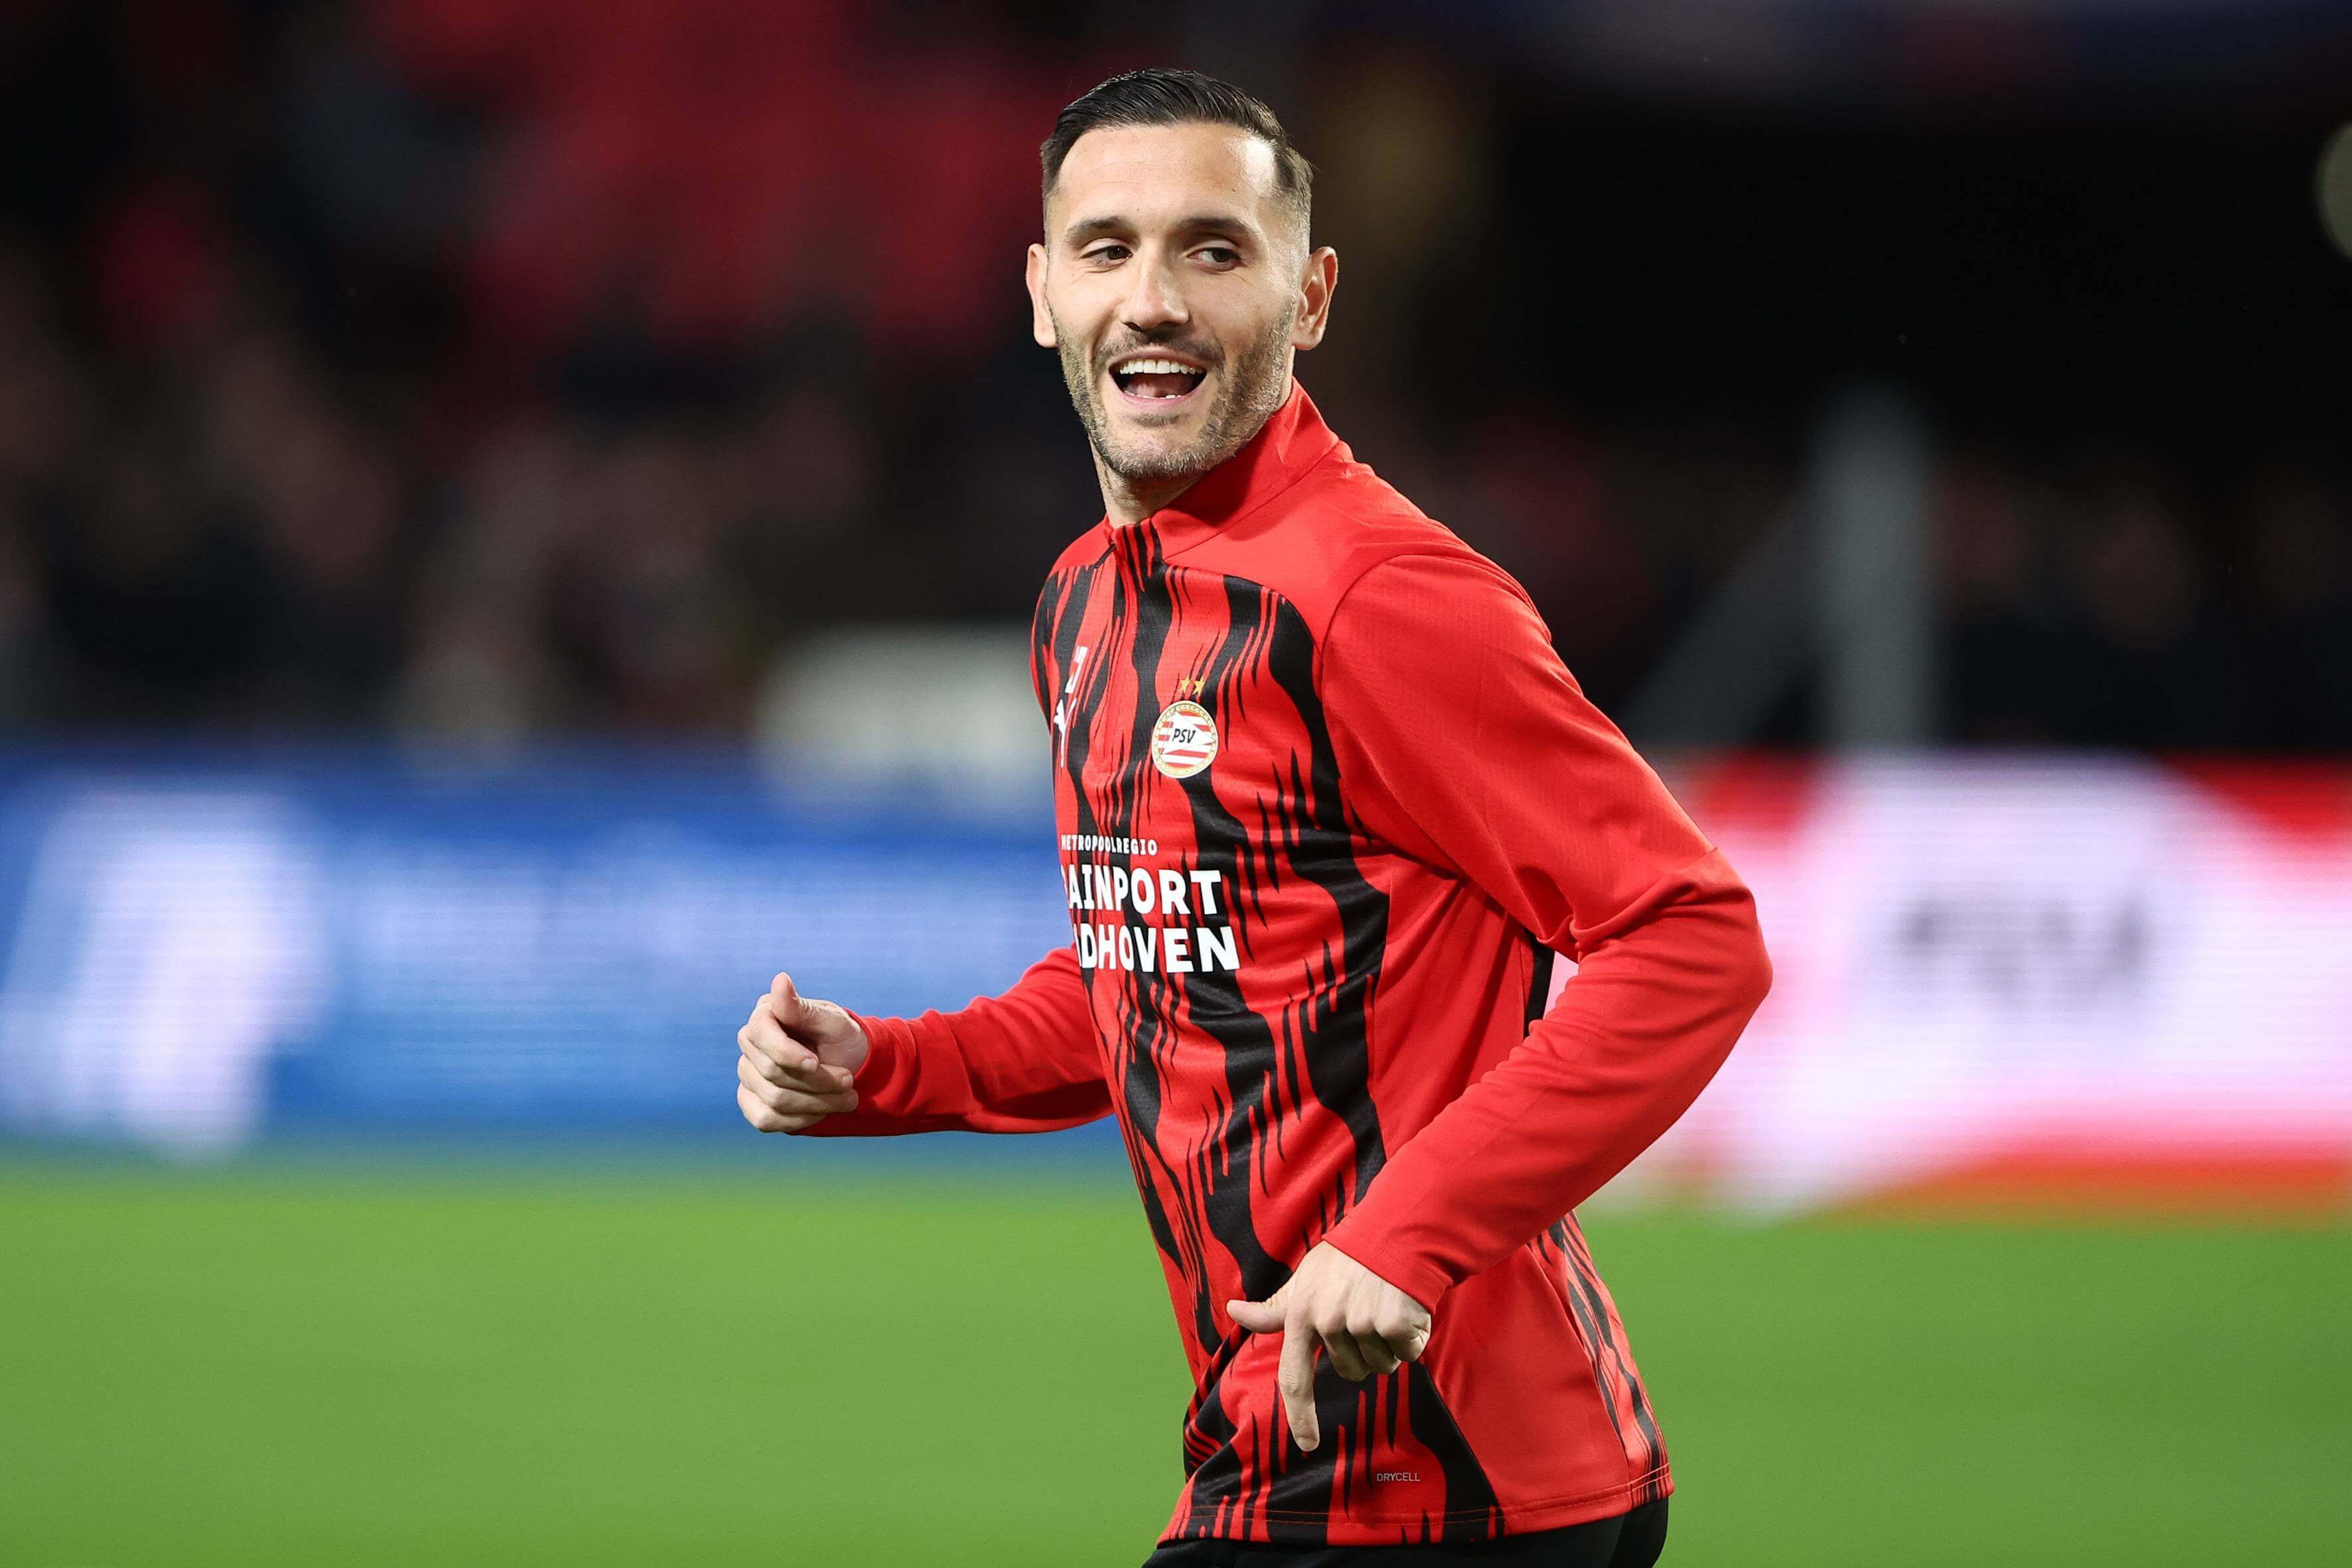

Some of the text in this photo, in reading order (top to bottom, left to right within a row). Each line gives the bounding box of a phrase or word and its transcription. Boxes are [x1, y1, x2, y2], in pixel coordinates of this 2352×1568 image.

[1172, 728, 1196, 744] PSV
[1061, 864, 1221, 915] AINPORT
[1376, 1472, 1421, 1482] DRYCELL
